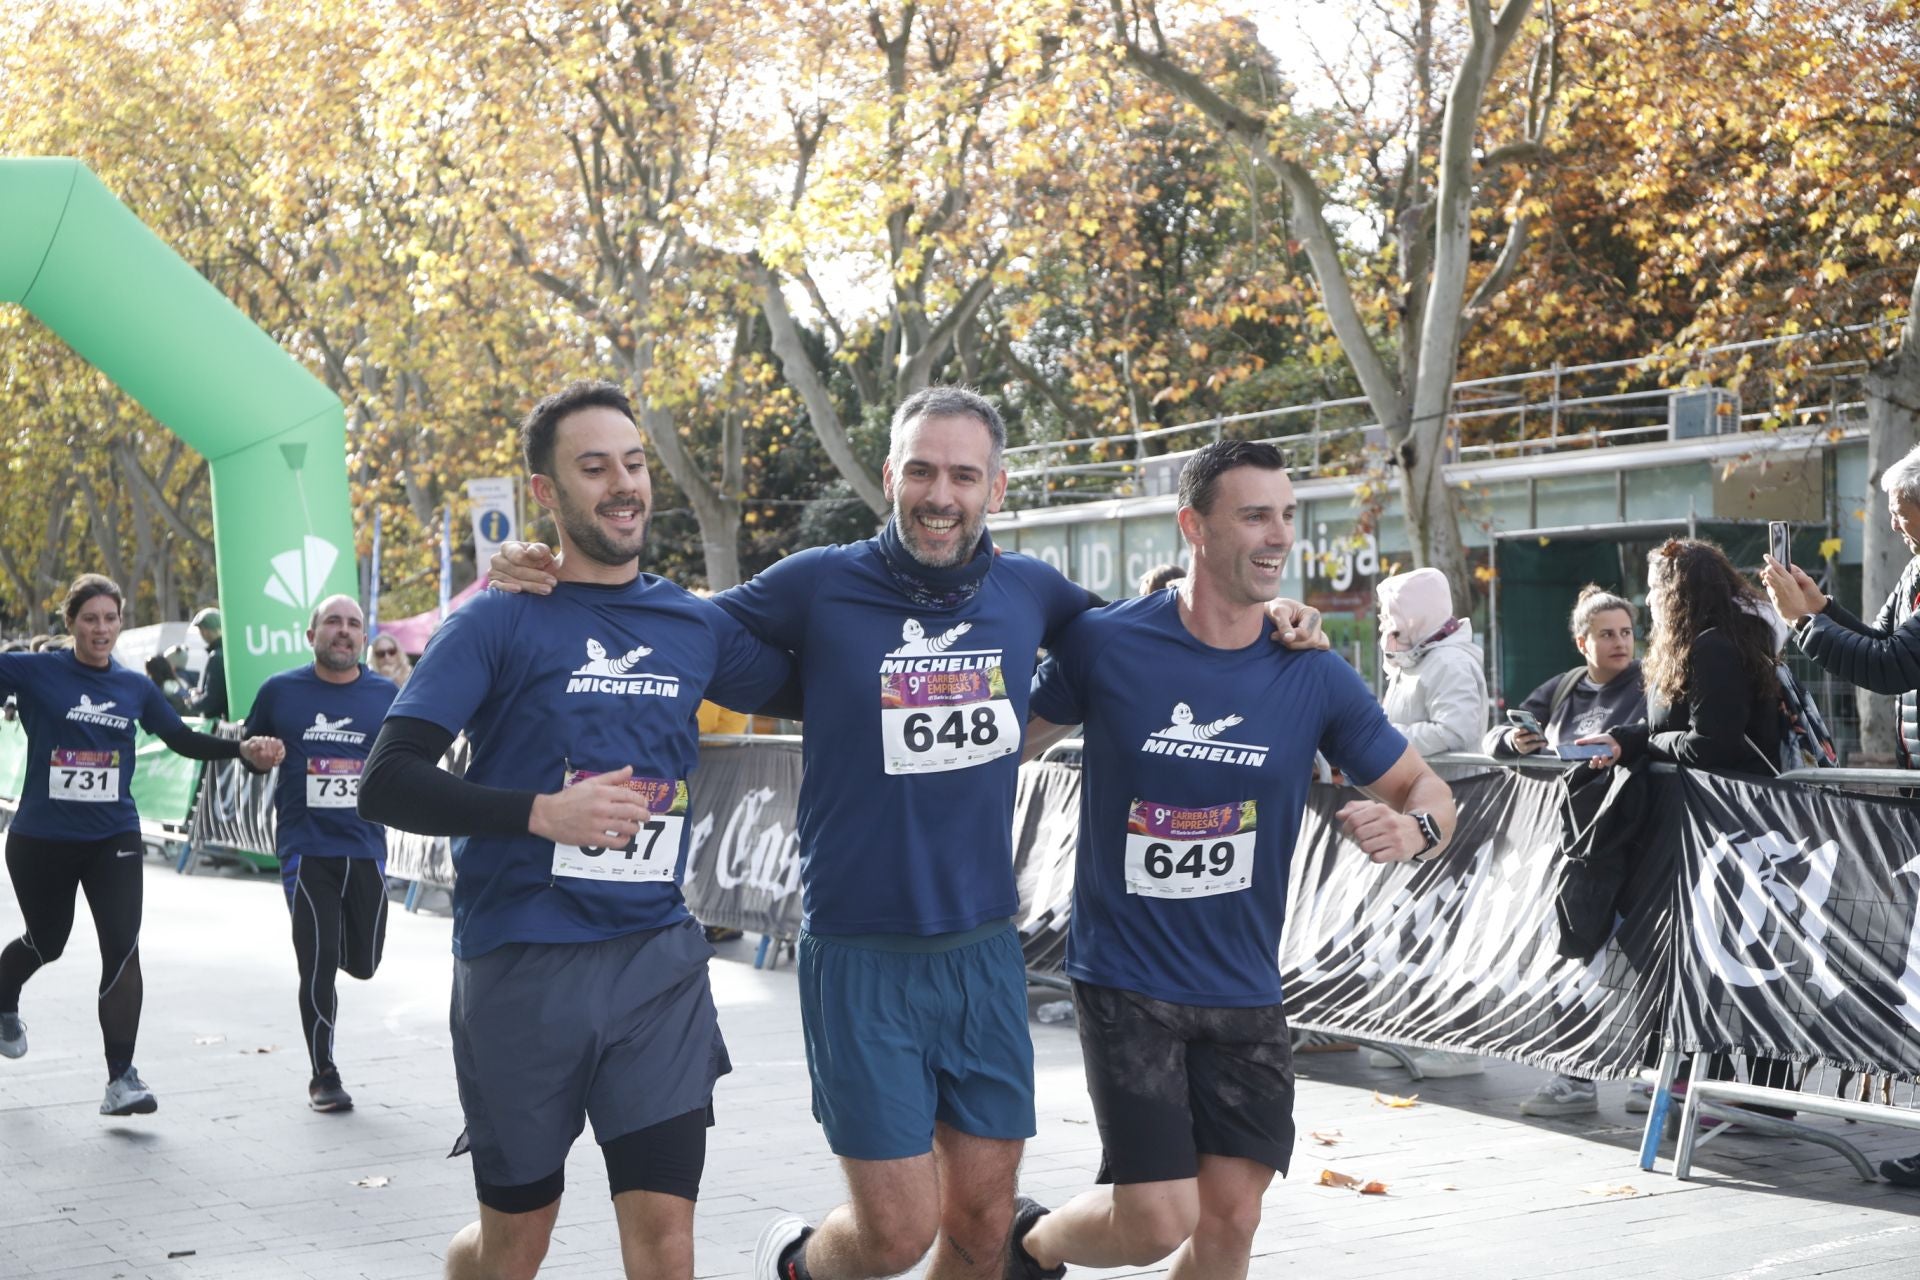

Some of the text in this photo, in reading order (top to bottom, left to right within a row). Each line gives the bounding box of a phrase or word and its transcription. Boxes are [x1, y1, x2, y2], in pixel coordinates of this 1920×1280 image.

[879, 655, 1002, 674] MICHELIN
[566, 678, 680, 698] MICHELIN
[927, 681, 972, 695] EMPRESAS
[65, 710, 128, 730] MICHELIN
[903, 706, 999, 753] 648
[303, 731, 364, 744] MICHELIN
[1141, 738, 1267, 768] MICHELIN
[61, 770, 108, 791] 731
[1154, 807, 1219, 826] 9ª CARRERA DE
[1171, 818, 1219, 830] EMPRESAS
[1144, 841, 1235, 879] 649
